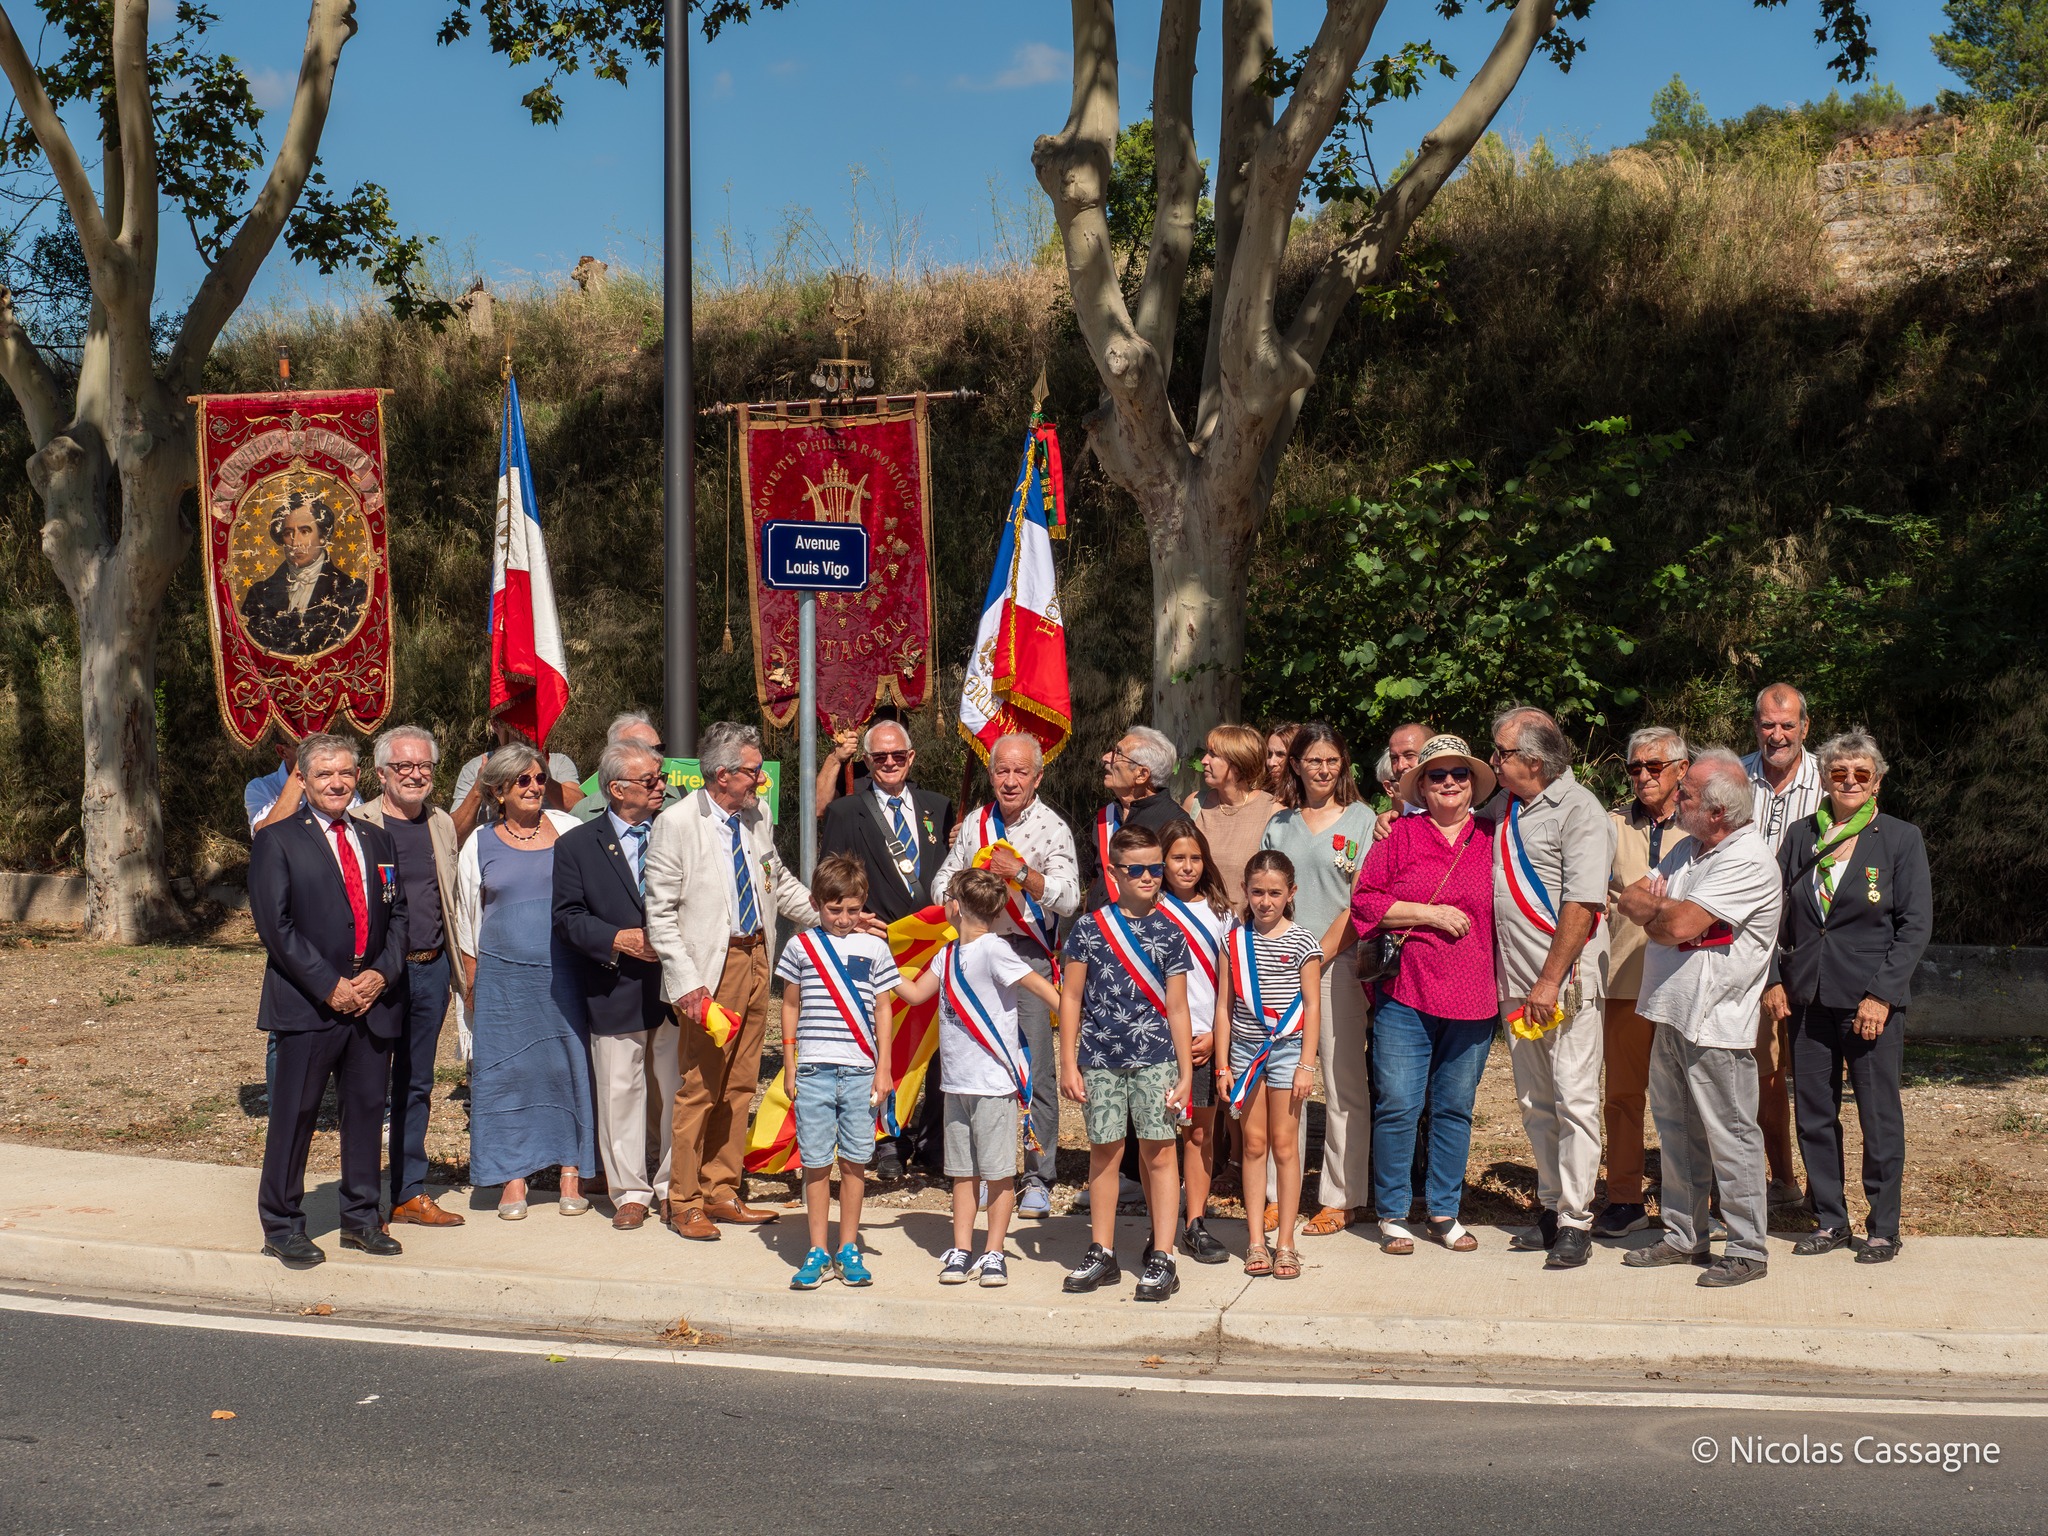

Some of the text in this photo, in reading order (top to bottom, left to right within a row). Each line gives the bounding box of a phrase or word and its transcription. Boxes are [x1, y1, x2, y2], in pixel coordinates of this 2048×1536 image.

[311, 429, 366, 469] ARAGO
[797, 438, 915, 510] PHILHARMONIQUE
[795, 535, 841, 551] Avenue
[786, 559, 850, 579] Louis Vigo
[777, 615, 908, 662] ETAGEL
[667, 770, 705, 789] dire
